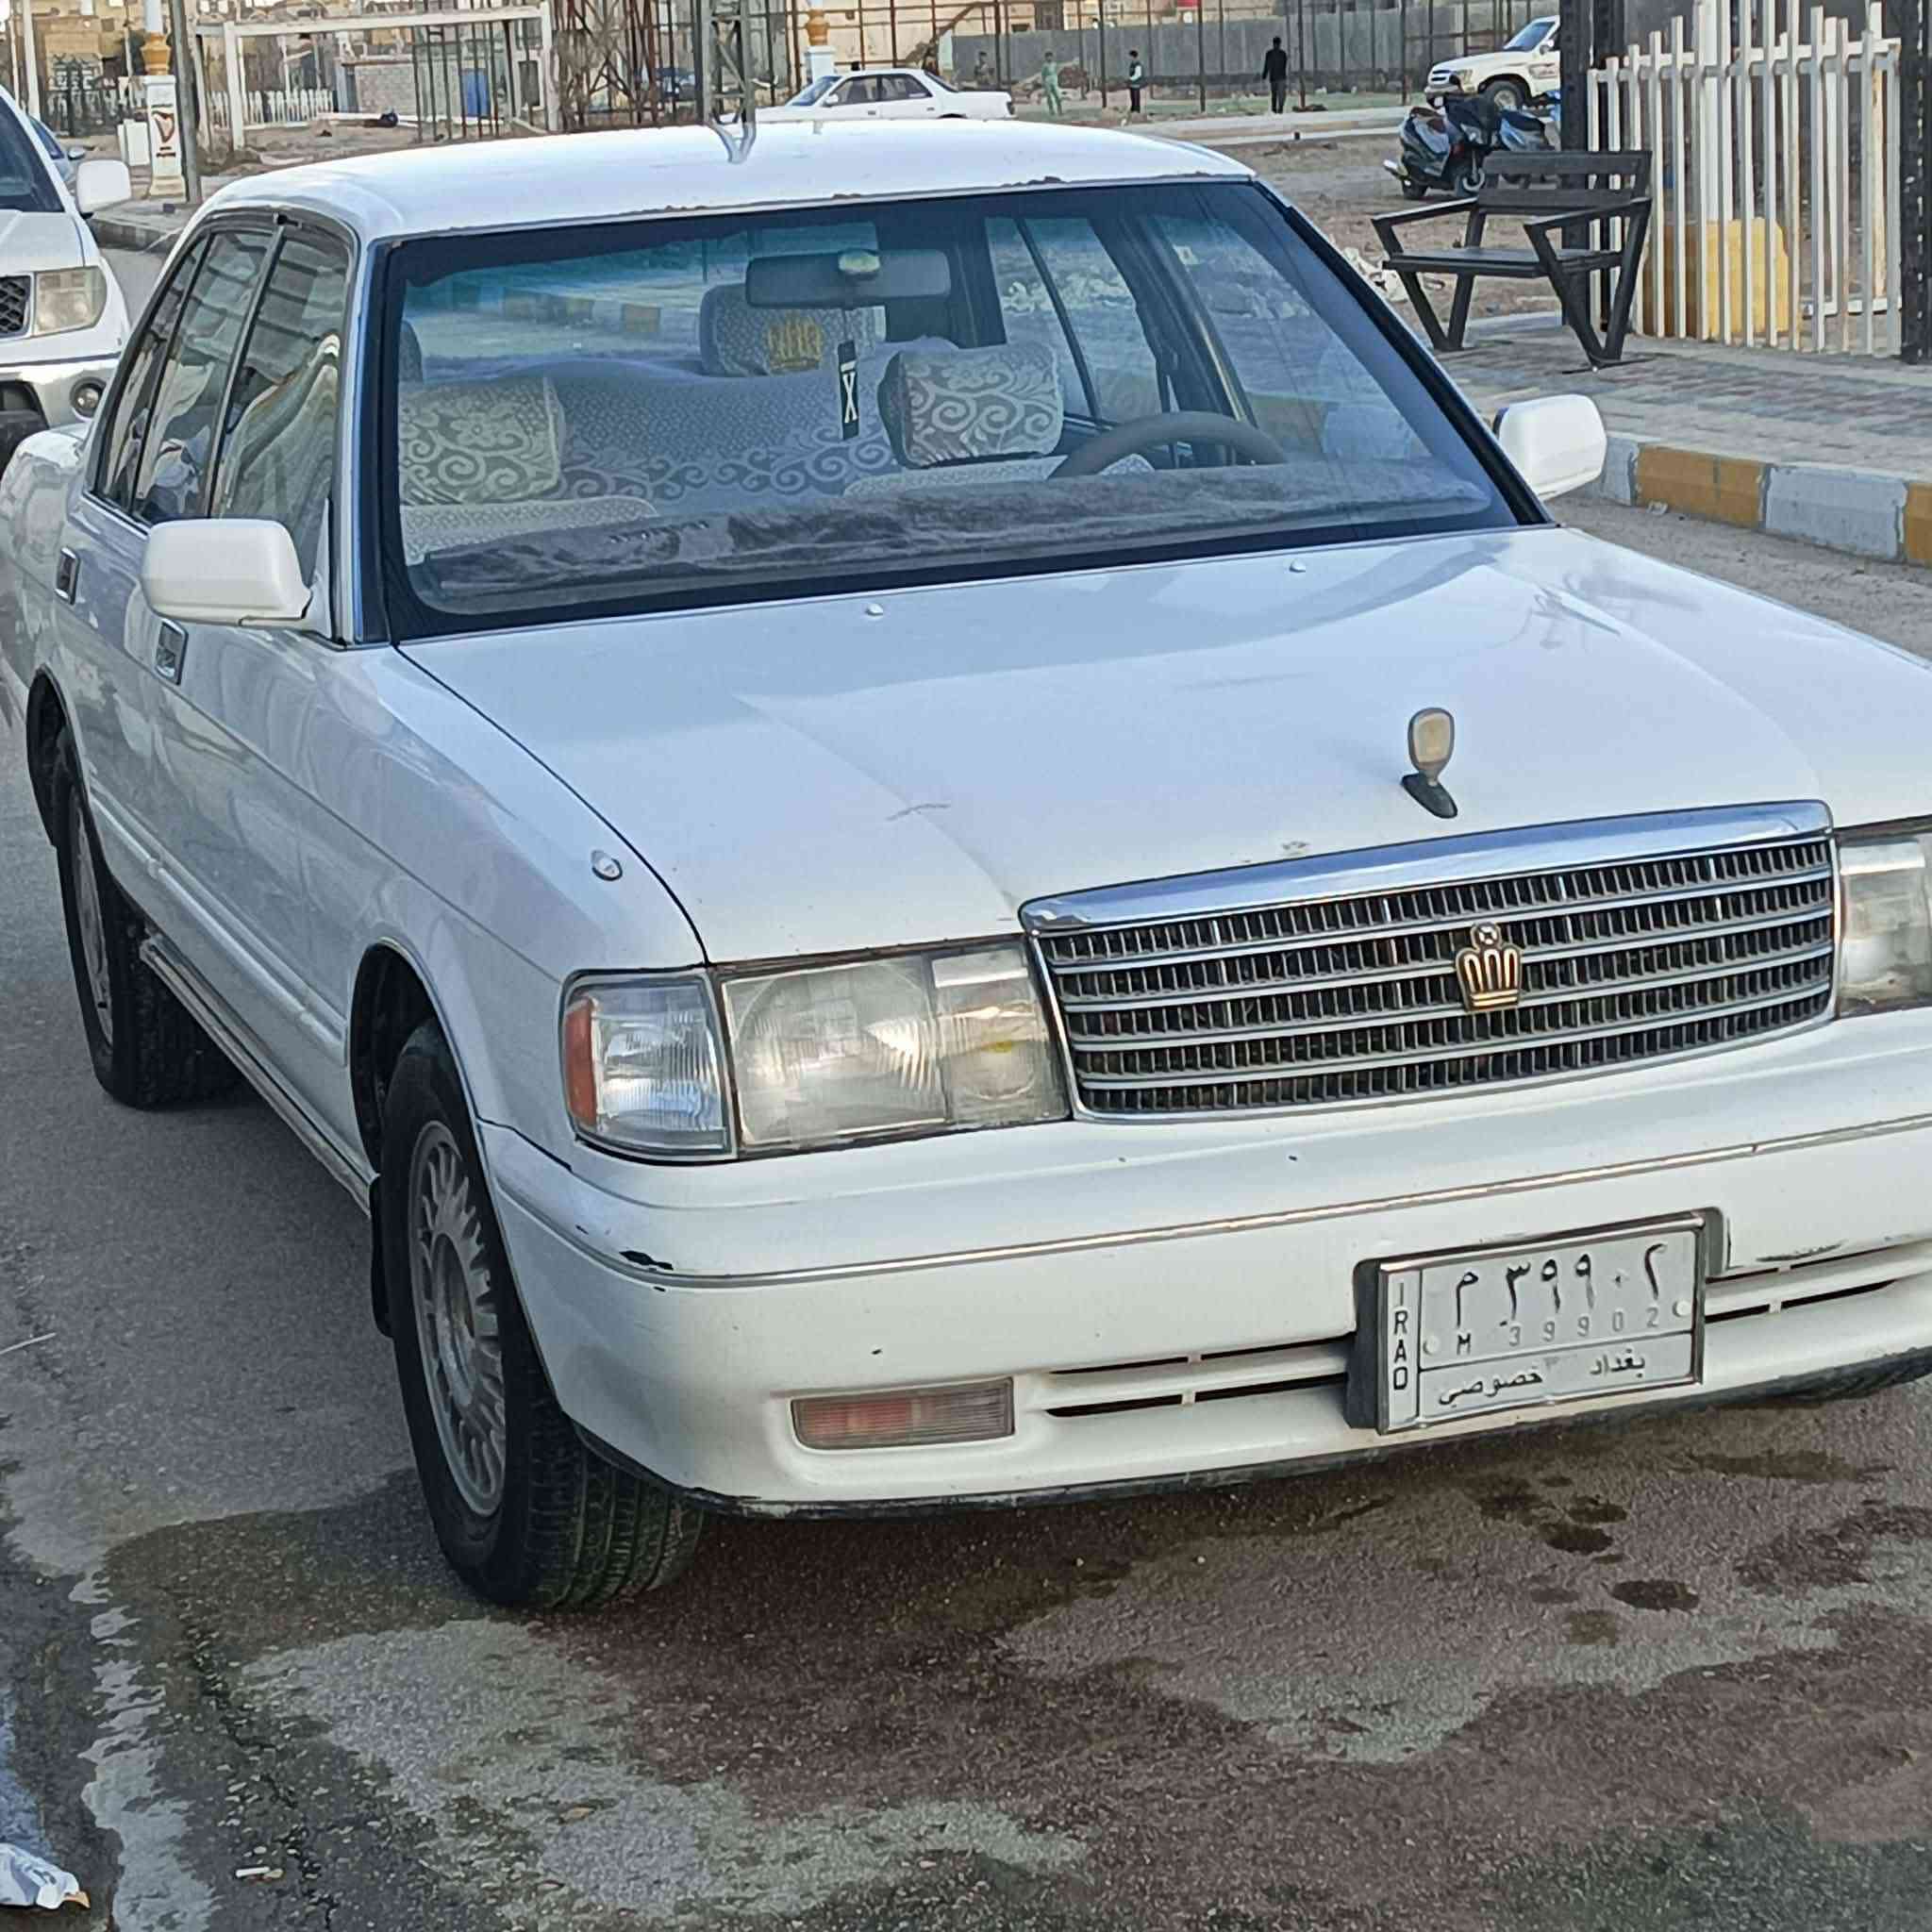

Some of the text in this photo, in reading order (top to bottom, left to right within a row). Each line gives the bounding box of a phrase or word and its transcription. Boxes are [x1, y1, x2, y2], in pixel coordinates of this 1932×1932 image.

[1508, 1306, 1659, 1347] 39902
[1439, 1347, 1646, 1408] بغداد خصوصي
